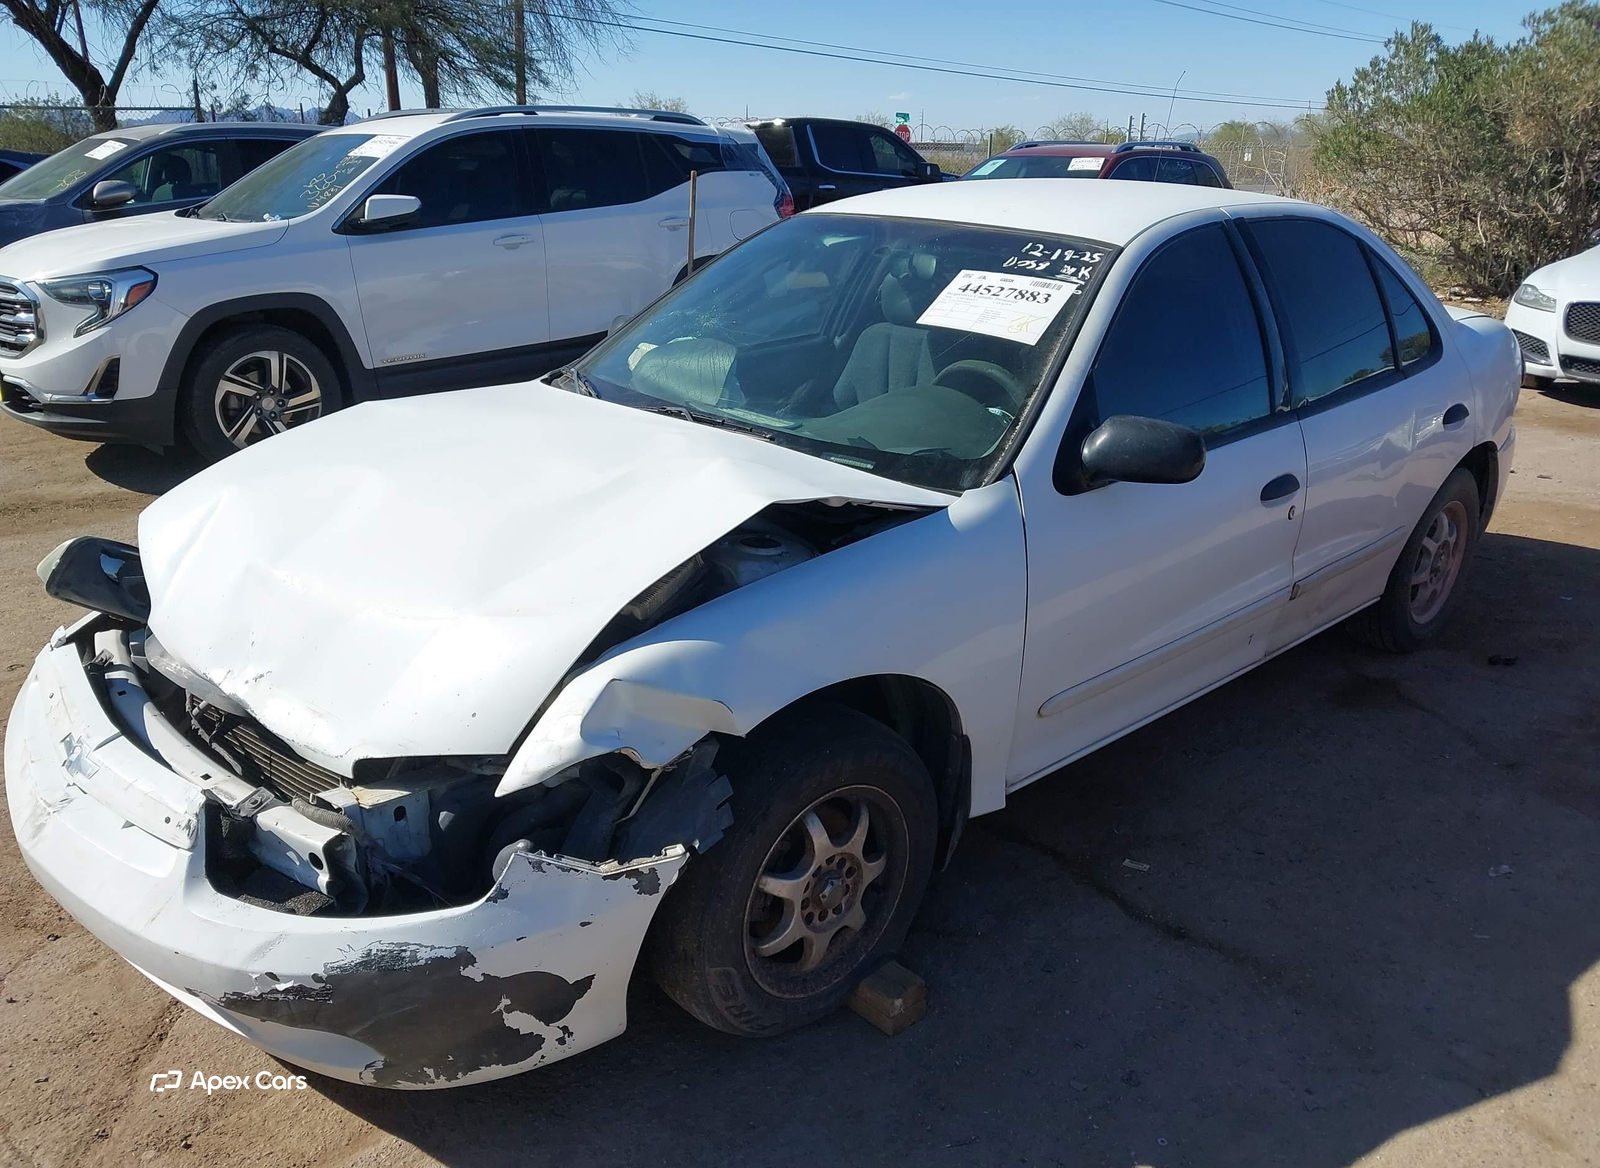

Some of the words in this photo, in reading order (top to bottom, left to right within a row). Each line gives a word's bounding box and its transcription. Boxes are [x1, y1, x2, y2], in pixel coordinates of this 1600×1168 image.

[895, 131, 910, 140] STOP
[1021, 242, 1105, 263] 12-19-25
[958, 283, 1052, 304] 44527883
